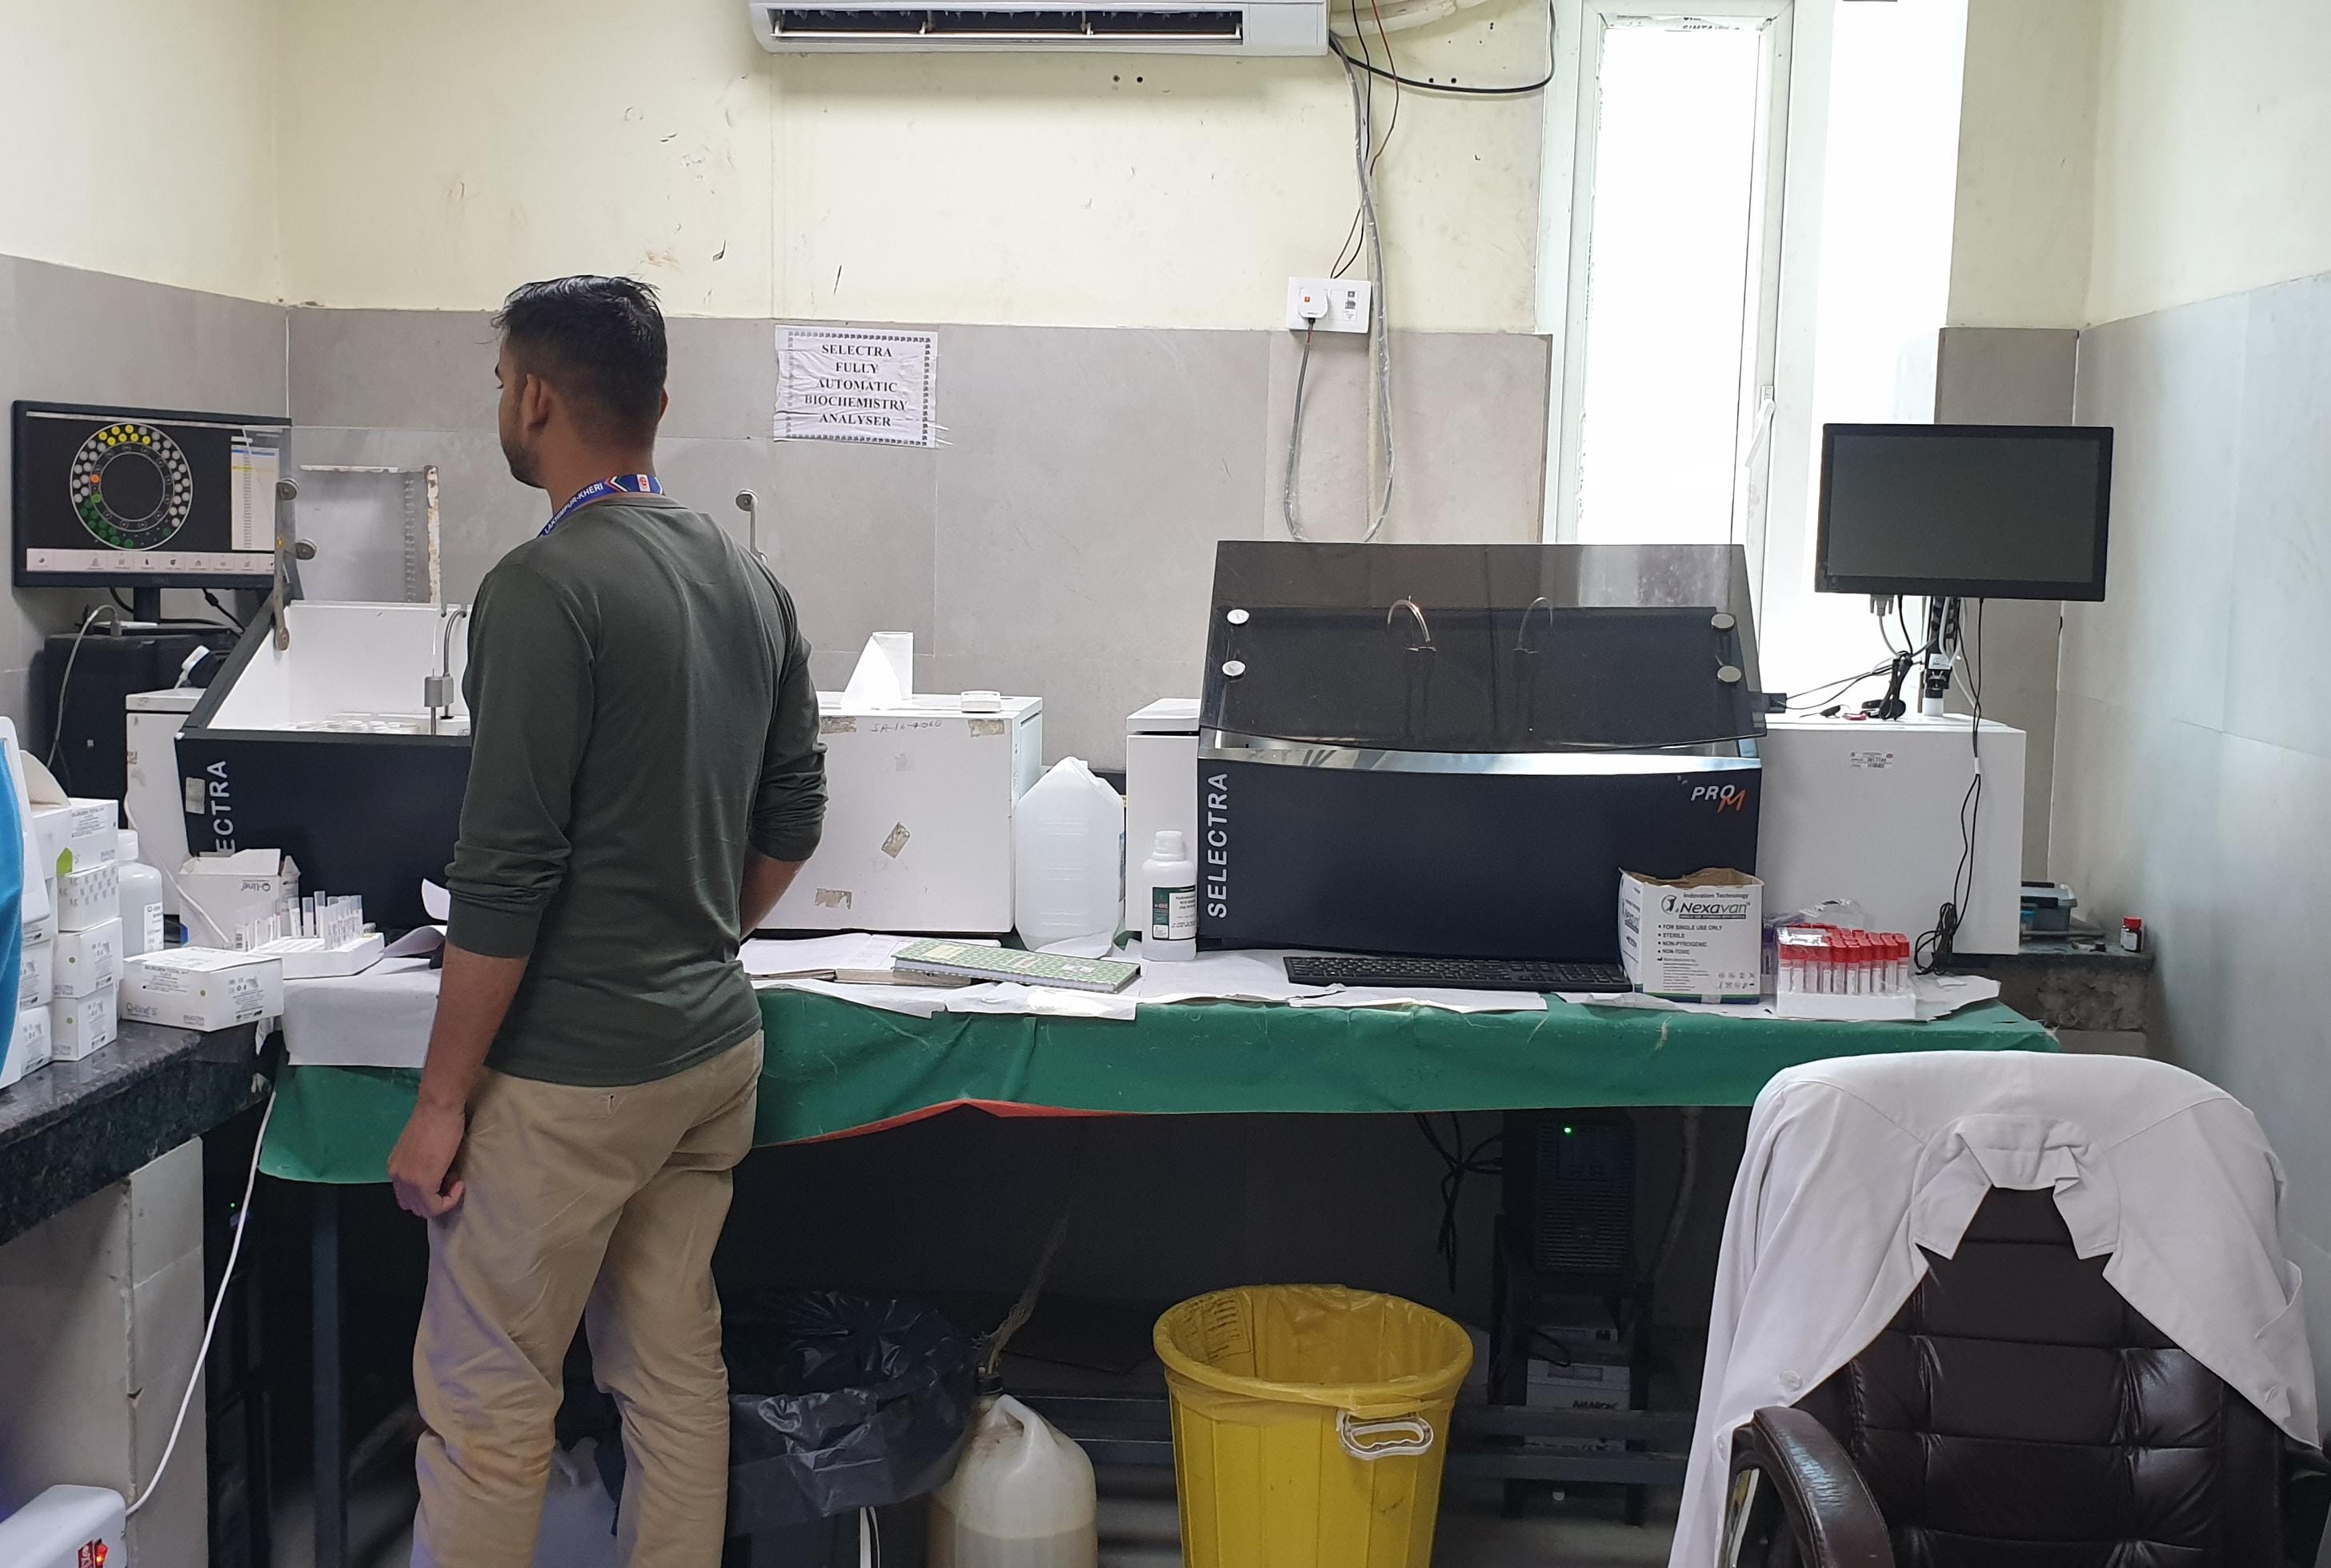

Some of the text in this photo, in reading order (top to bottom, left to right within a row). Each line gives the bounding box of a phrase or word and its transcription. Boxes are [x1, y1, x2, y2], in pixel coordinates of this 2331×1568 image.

[822, 344, 892, 358] SELECTRA
[835, 362, 879, 374] FULLY
[815, 378, 898, 393] AUTOMATIC
[804, 394, 908, 411] BIOCHEMISTRY
[819, 414, 891, 426] ANALYSER
[544, 482, 604, 534] LAKHIMPUR-KHERI
[1690, 784, 1746, 814] PRO M
[1207, 773, 1228, 920] SELECTRA
[1680, 902, 1748, 914] Nexavan
